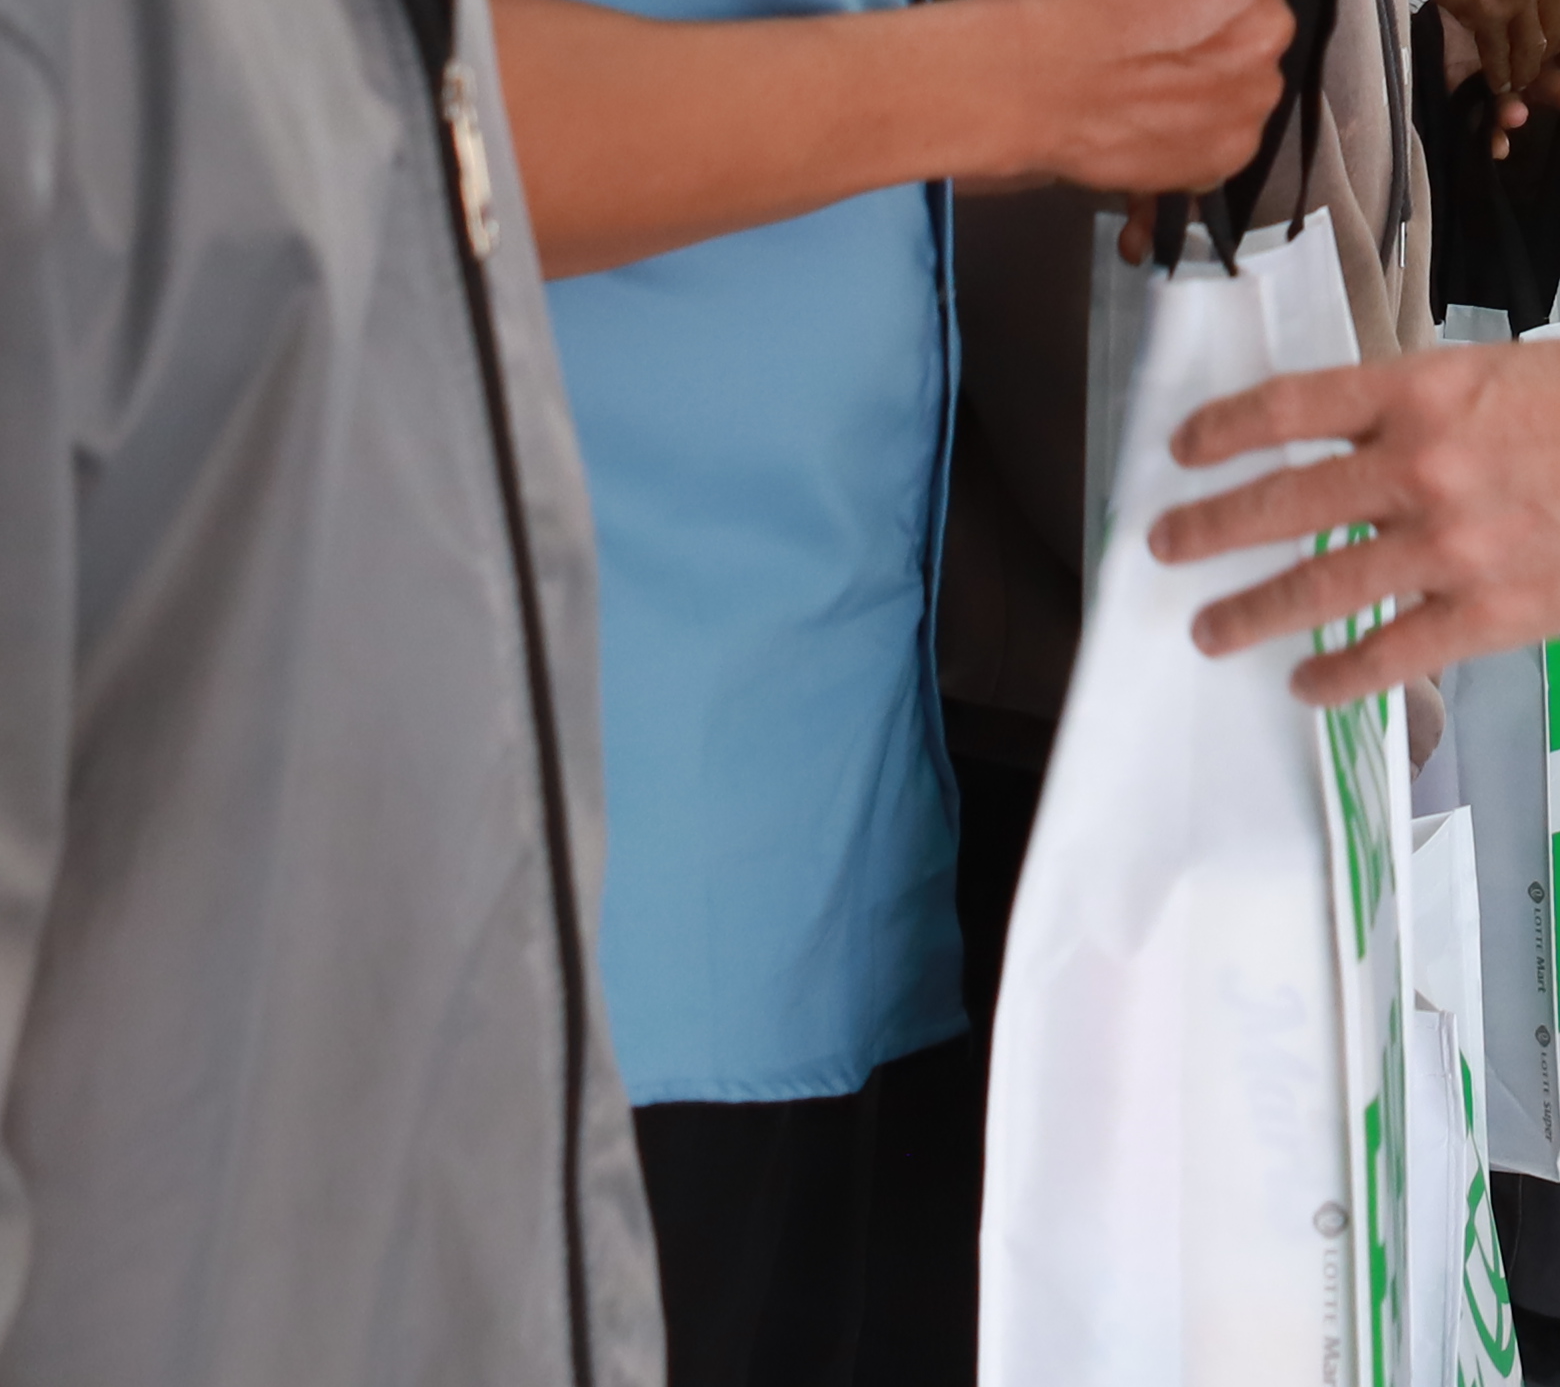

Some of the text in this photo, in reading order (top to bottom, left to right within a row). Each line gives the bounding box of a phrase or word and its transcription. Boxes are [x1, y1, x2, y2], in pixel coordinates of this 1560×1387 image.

[1533, 907, 1547, 994] LOTTE Mart
[1321, 1335, 1342, 1387] Mar
